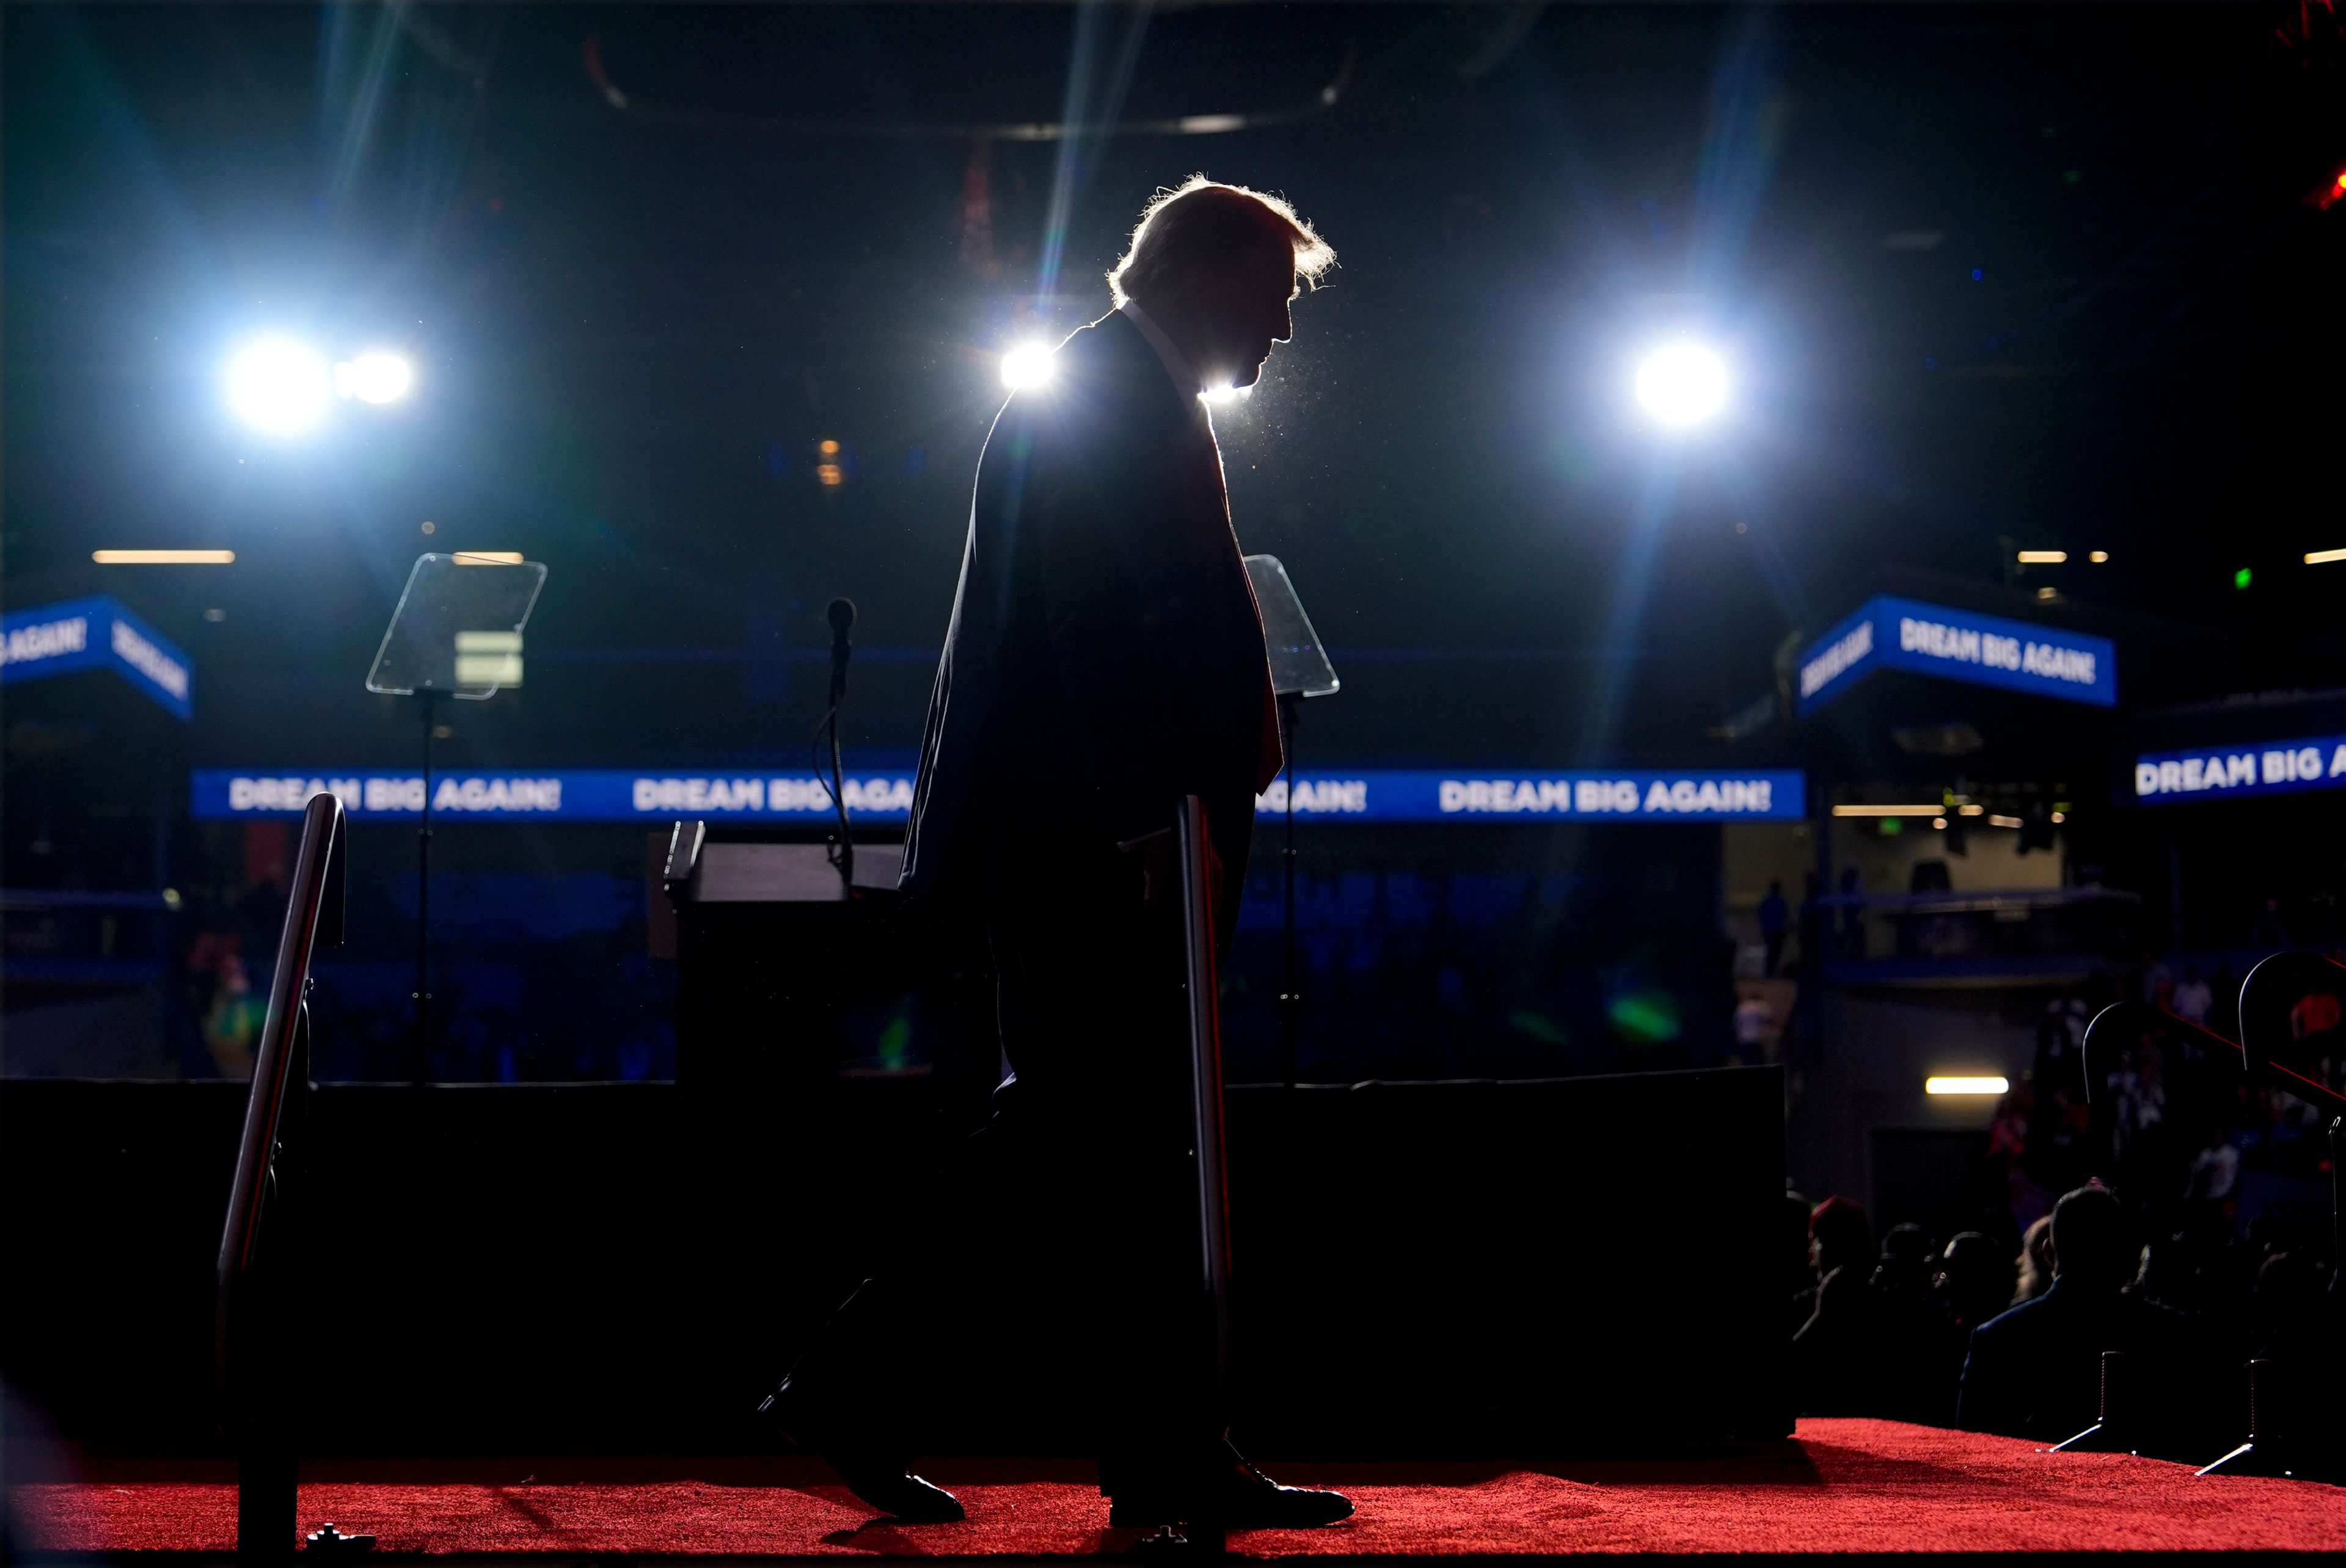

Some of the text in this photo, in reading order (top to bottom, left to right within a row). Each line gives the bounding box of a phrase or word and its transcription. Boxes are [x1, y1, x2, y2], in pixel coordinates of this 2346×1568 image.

[1900, 618, 1981, 664] DREAM
[1981, 632, 2022, 671] BIG
[2022, 641, 2096, 685] AGAIN!
[2135, 753, 2256, 796] DREAM
[2262, 746, 2323, 784] BIG
[364, 778, 426, 811] BIG
[431, 778, 562, 811] AGAIN!
[632, 778, 765, 811] DREAM
[767, 778, 833, 811] BIG
[1439, 779, 1772, 813] DREAM BIG AGAIN!
